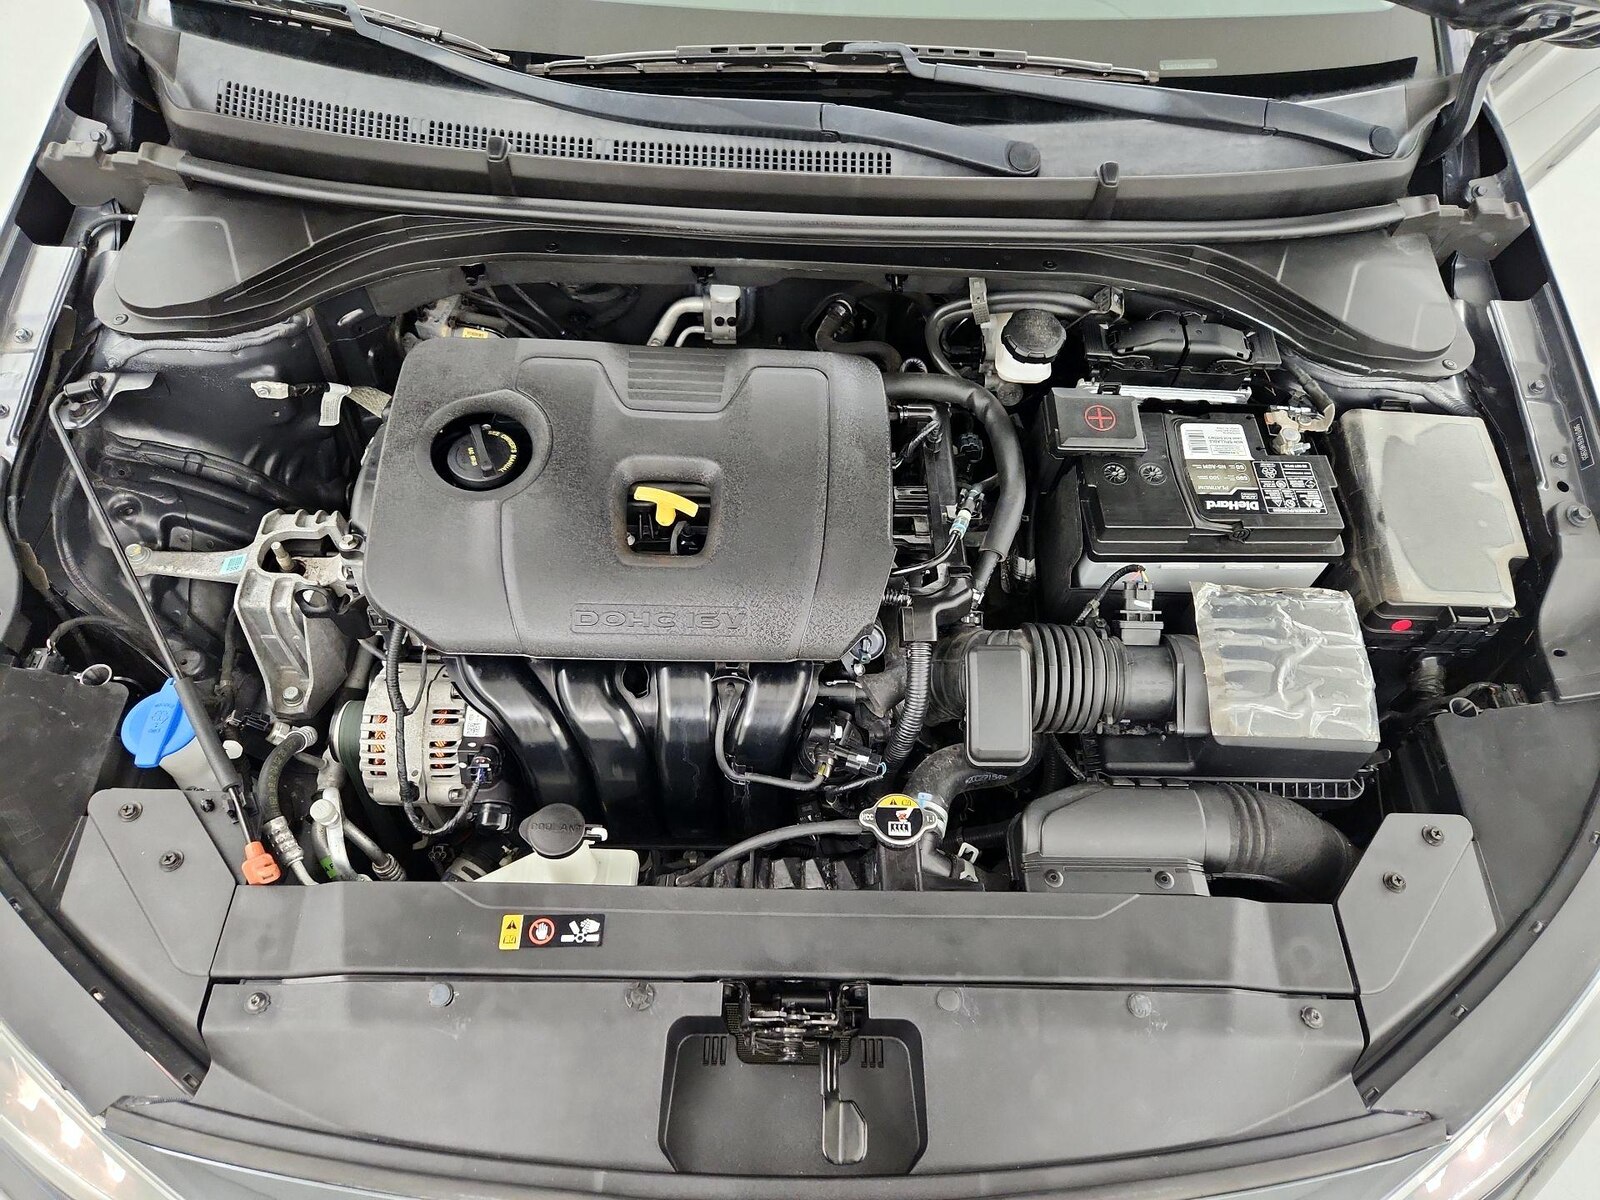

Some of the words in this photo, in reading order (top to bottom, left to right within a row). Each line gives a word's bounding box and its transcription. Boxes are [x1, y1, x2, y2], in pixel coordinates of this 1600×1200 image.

[1205, 500, 1260, 511] DieHard
[574, 610, 677, 628] DOHC
[687, 611, 747, 630] 16V
[530, 822, 583, 833] COOLANT
